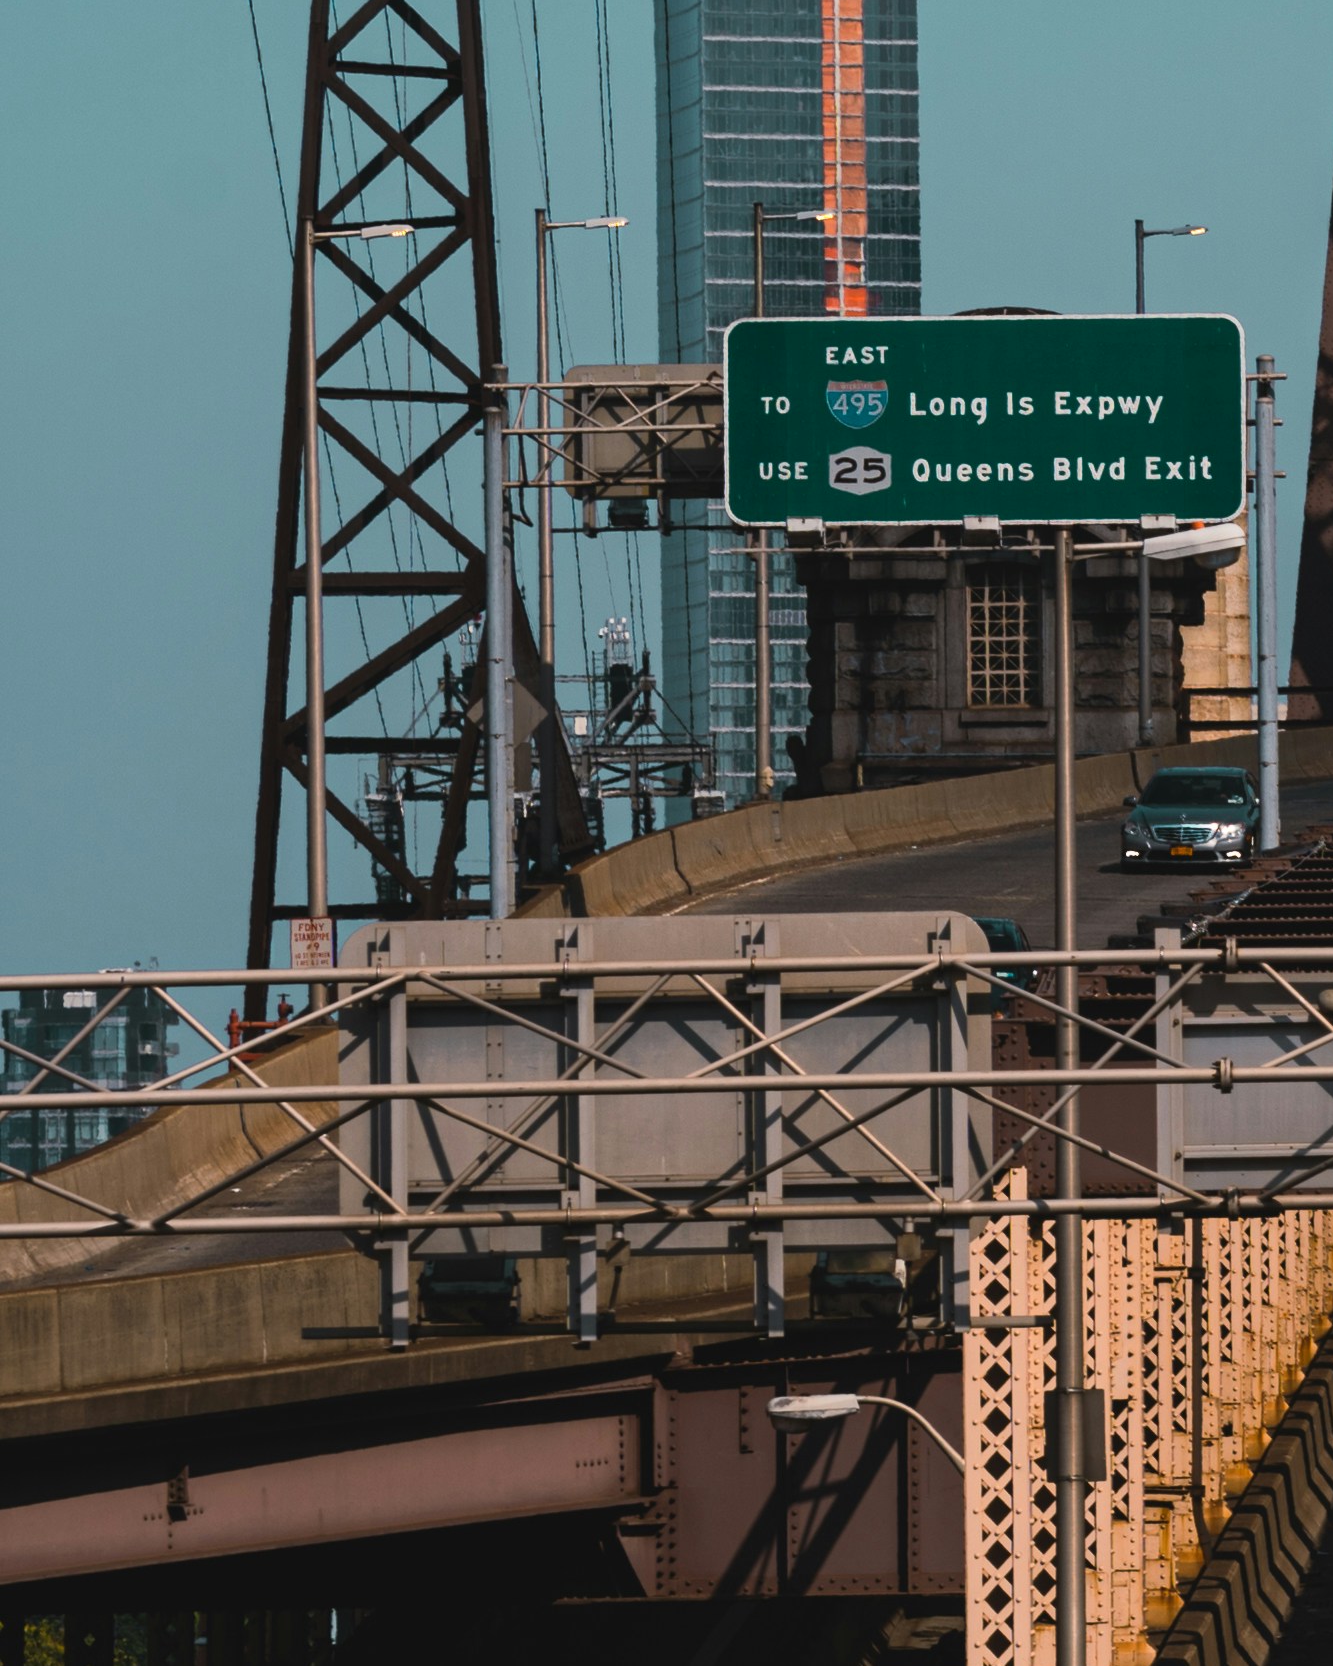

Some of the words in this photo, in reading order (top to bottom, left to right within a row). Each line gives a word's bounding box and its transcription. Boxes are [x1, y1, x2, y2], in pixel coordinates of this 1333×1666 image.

[826, 346, 889, 365] EAST
[761, 396, 791, 414] TO
[832, 393, 883, 416] 495
[909, 392, 988, 425] Long
[1006, 392, 1035, 416] Is
[1054, 391, 1164, 424] Expwy
[759, 461, 809, 481] USE
[834, 456, 887, 484] 25
[912, 458, 1035, 483] Queens
[1053, 456, 1126, 482] Blvd
[1145, 456, 1213, 480] Exit
[298, 922, 325, 932] FDNY
[293, 933, 331, 943] STANDPIPE
